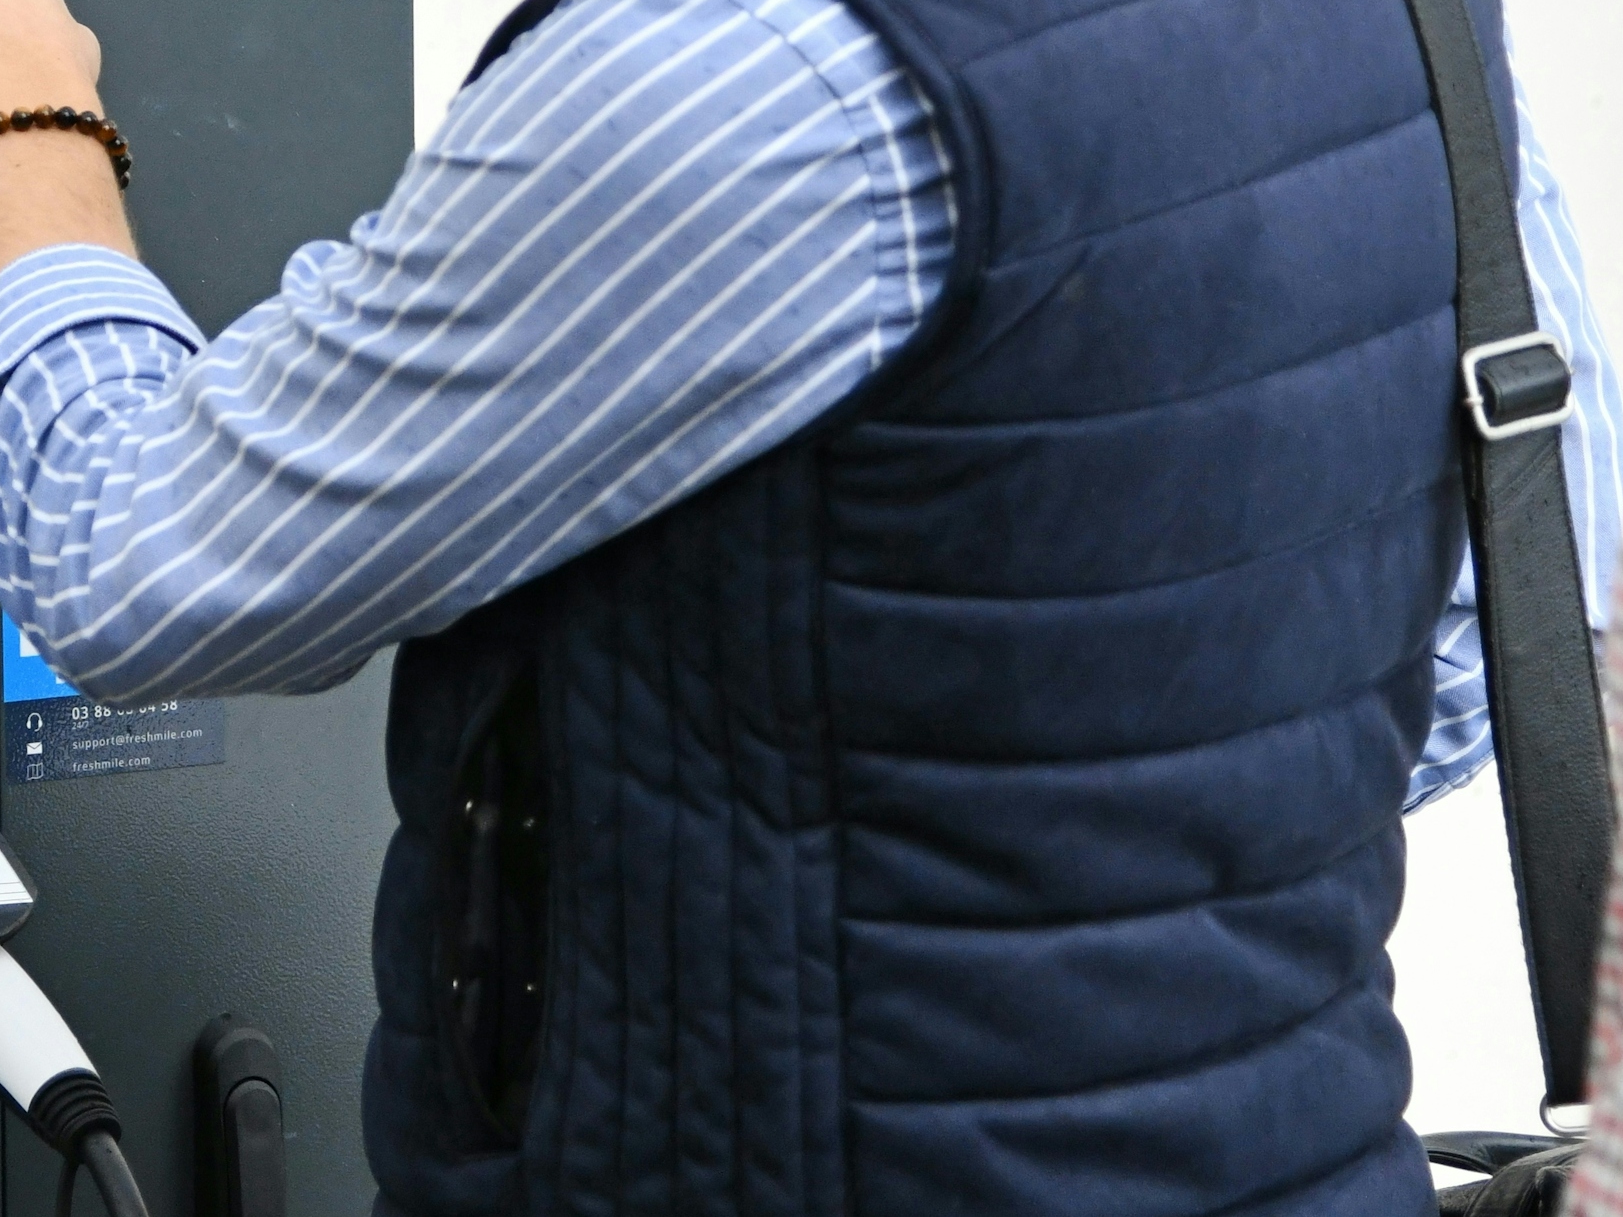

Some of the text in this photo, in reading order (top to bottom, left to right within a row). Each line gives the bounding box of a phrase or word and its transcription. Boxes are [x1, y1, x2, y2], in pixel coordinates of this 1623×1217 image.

[72, 706, 88, 720] 03
[73, 729, 202, 750] support@freshmile.com
[73, 756, 150, 772] freshmile.com
